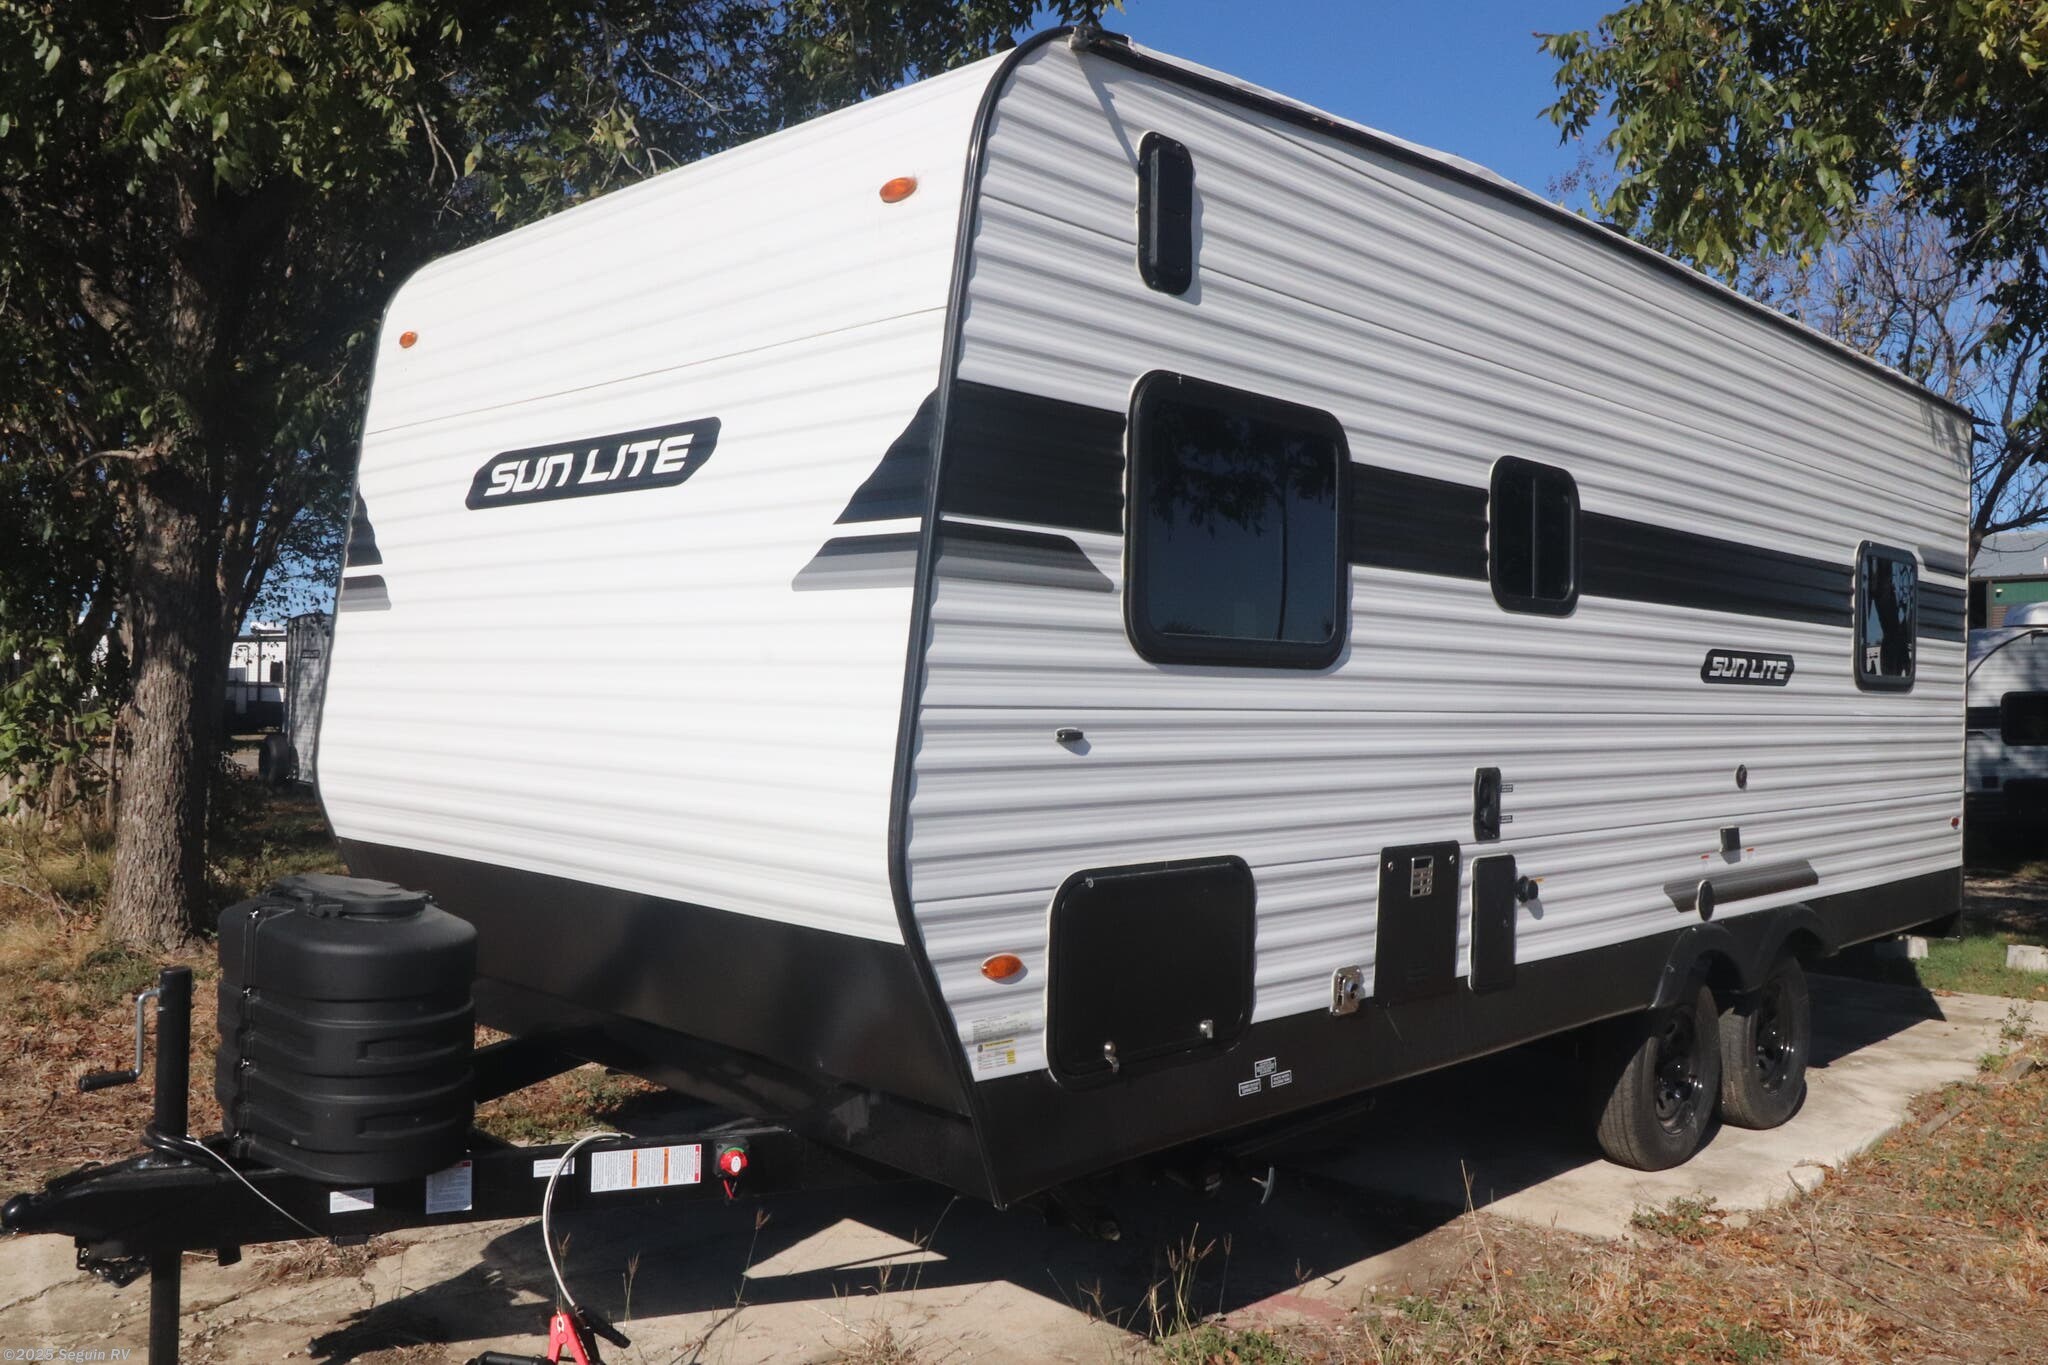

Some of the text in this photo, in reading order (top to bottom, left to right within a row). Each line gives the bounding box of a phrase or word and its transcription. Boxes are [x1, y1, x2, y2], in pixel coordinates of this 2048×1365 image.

[484, 433, 694, 496] SUN LITE
[1709, 657, 1788, 680] SUN LITE
